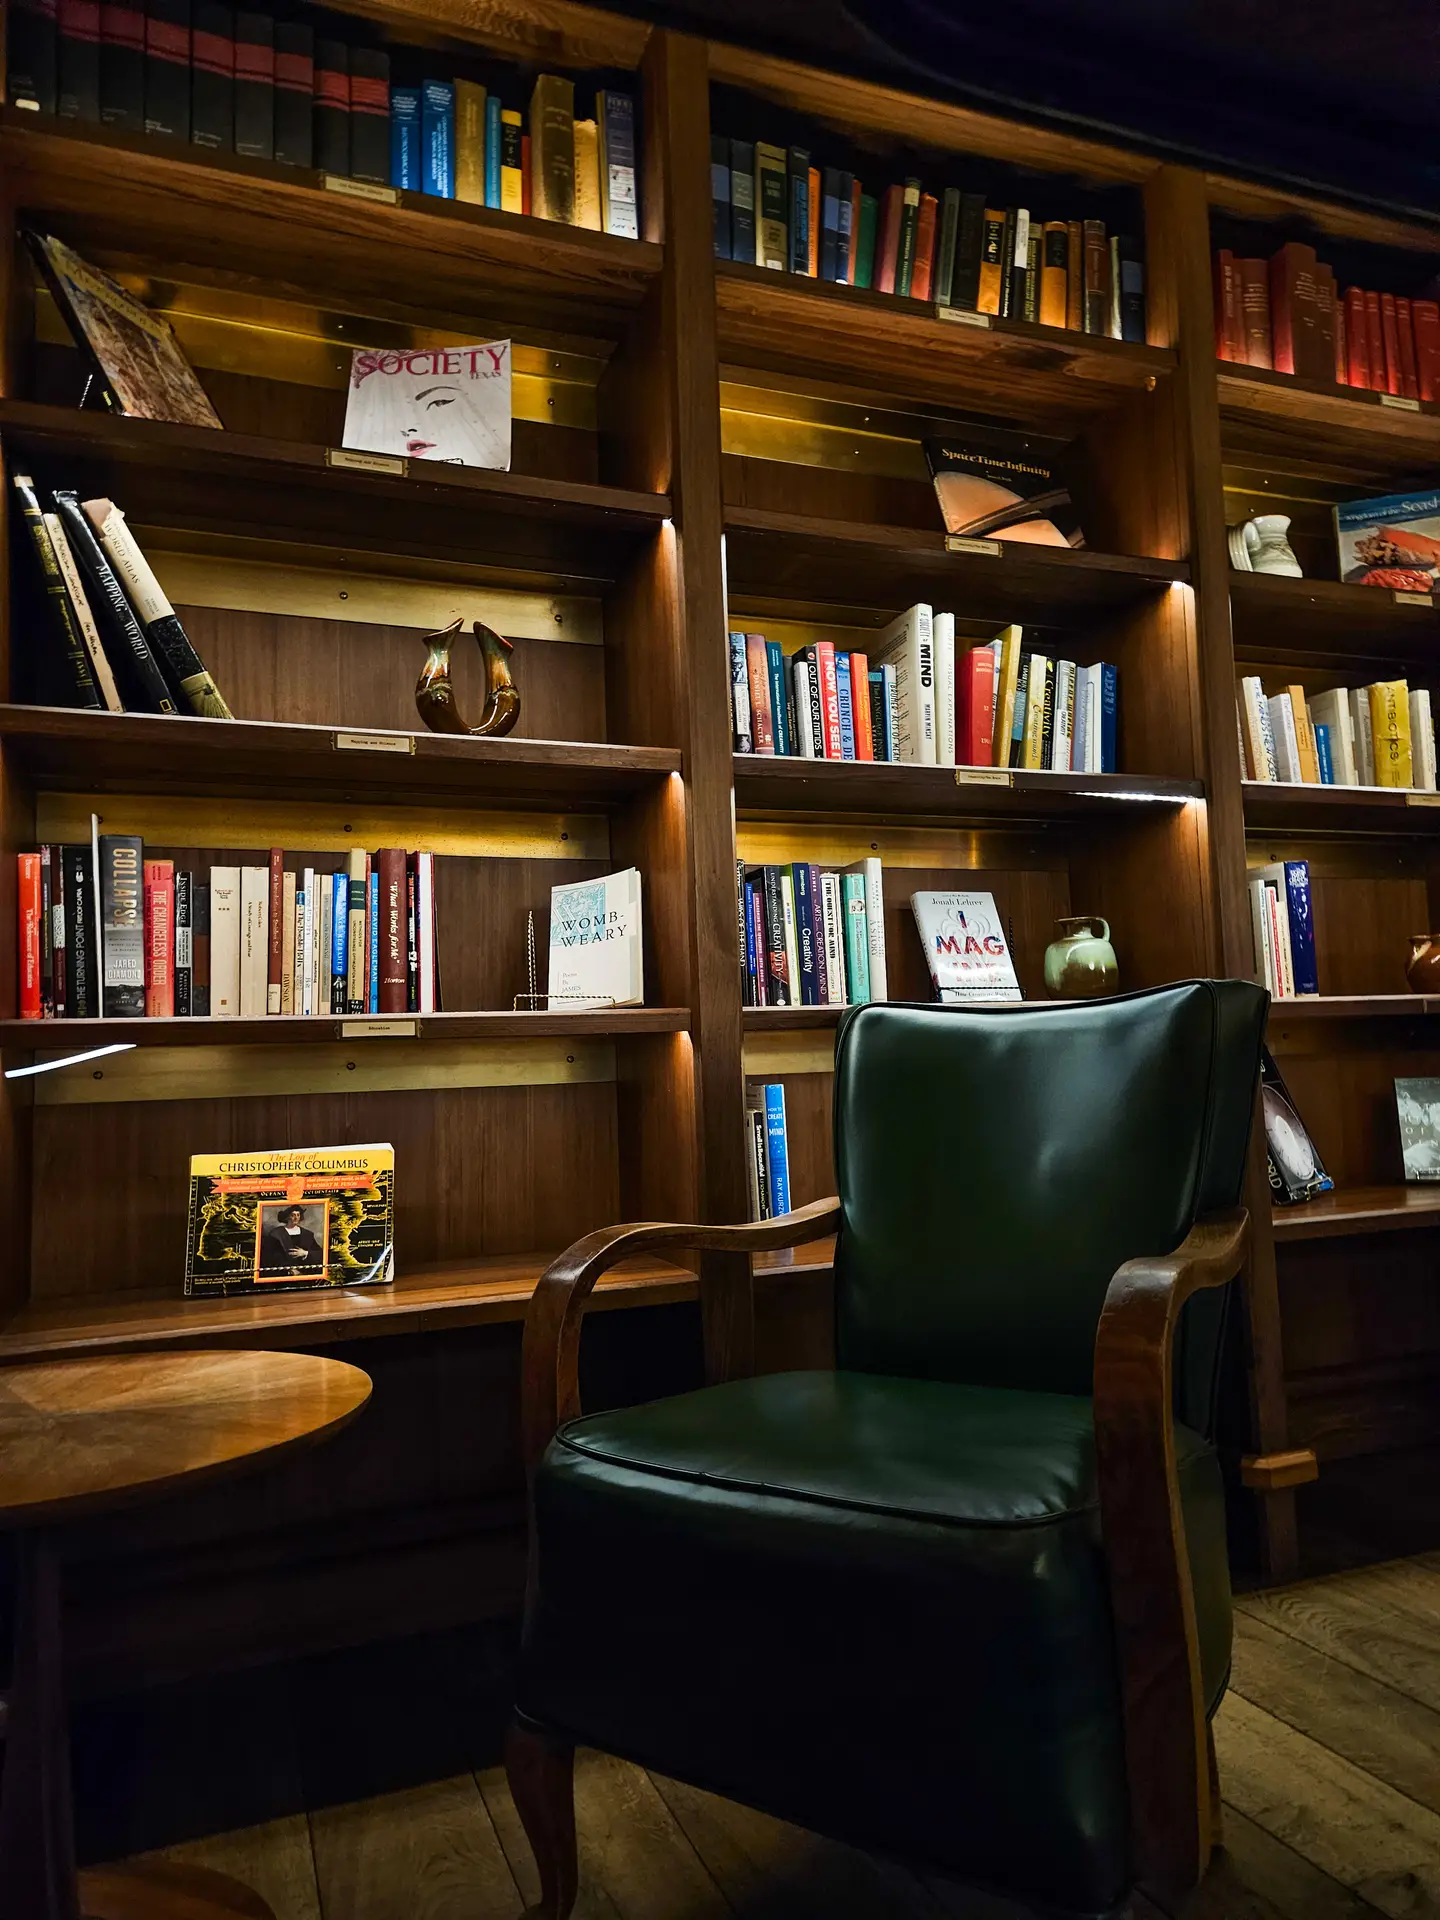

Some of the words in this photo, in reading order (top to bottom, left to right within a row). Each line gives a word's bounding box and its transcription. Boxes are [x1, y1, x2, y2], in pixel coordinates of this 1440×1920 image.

[356, 345, 508, 376] SOCIETY
[95, 565, 127, 613] MAPPING
[123, 620, 148, 661] WORLD
[808, 665, 817, 685] OUT
[825, 661, 836, 693] NOW
[920, 643, 932, 688] MIND
[753, 674, 761, 700] DANIEL
[810, 685, 818, 699] OF
[1067, 666, 1075, 701] mirror
[827, 694, 838, 723] YOU
[889, 684, 898, 710] BRUNER
[1042, 679, 1054, 738] Creativity
[811, 700, 820, 721] OUR
[839, 689, 851, 731] CRUNCH
[875, 695, 884, 737] LANGUAGE
[891, 714, 899, 730] ACTS
[1031, 704, 1042, 737] Creating
[755, 709, 764, 744] SCHACTER
[813, 721, 822, 750] MINDS
[892, 730, 900, 740] OF
[924, 721, 932, 740] MINSKY
[1059, 711, 1067, 737] CREATIVITY
[1386, 686, 1400, 760] ANTIBIOTICS
[830, 725, 840, 750] SEE
[843, 735, 852, 743] &
[75, 887, 83, 907] CAPRA
[112, 847, 138, 927] COLLAPSE
[152, 889, 167, 906] THE
[179, 877, 188, 903] INSIDE
[770, 872, 779, 923] UNDERSTANDING
[179, 904, 188, 925] EDGE
[814, 904, 822, 922] ARTS
[826, 897, 834, 921] QUEST
[931, 897, 956, 907] Jonah
[957, 898, 984, 907] Lehrer
[26, 909, 34, 921] The
[390, 909, 399, 933] Works
[561, 911, 625, 931] WOMB-
[957, 910, 968, 928] I
[26, 921, 34, 952] Relevance
[75, 924, 85, 949] POINT
[152, 906, 167, 958] CHANGELESS
[560, 924, 627, 947] WEARY
[870, 928, 878, 957] STORY
[26, 952, 34, 960] of
[772, 922, 784, 974] CREATIVITY
[801, 927, 813, 973] Creativity
[816, 931, 824, 970] CREATION
[935, 935, 1005, 956] MAG
[26, 959, 34, 989] Education
[75, 949, 86, 986] TURNING
[113, 958, 136, 969] JARED
[152, 959, 167, 986] ORDER
[76, 986, 86, 1000] THE
[819, 973, 827, 995] MIND
[755, 1124, 763, 1143] Small
[219, 1159, 302, 1173] CHRISTOPHER
[304, 1158, 369, 1170] COLUMBUS
[268, 1152, 286, 1162] The
[289, 1152, 306, 1163] Log
[308, 1151, 320, 1160] of
[757, 1148, 765, 1177] Beautiful
[776, 1177, 784, 1191] RAY
